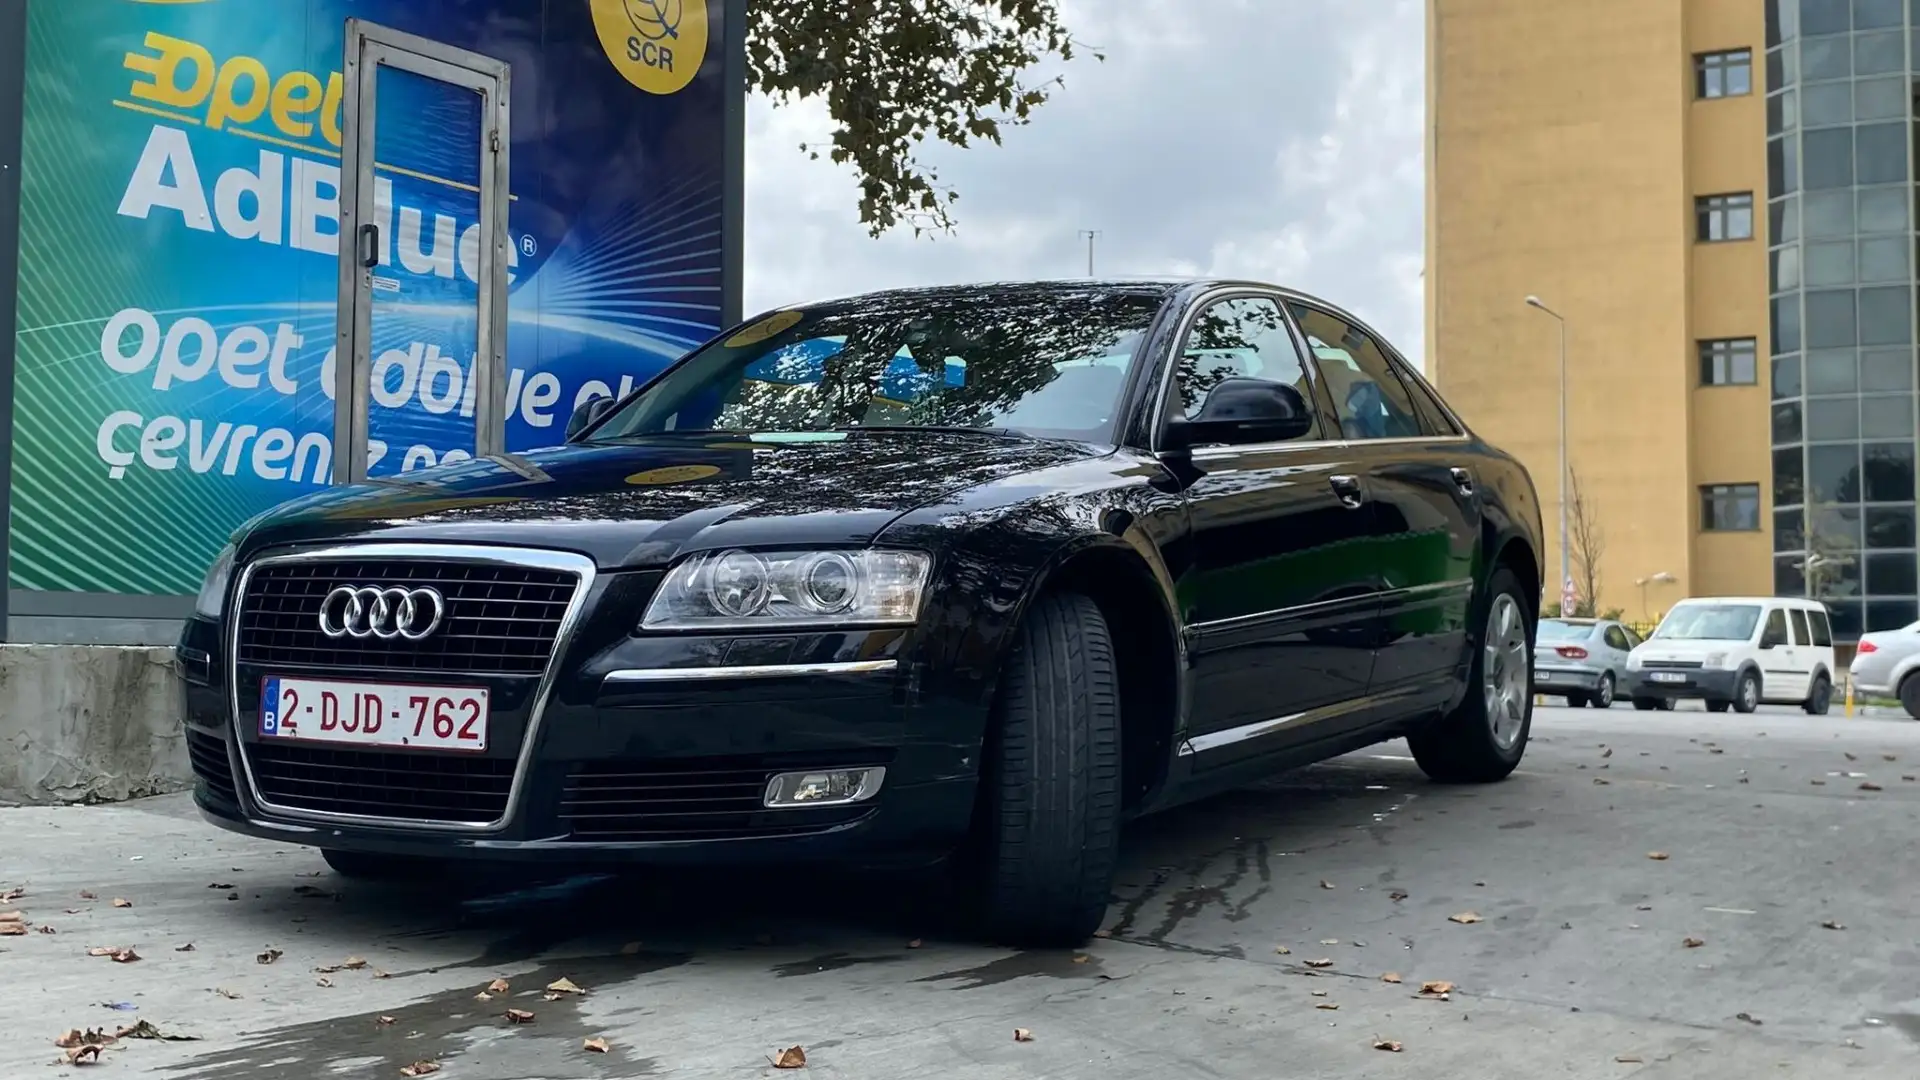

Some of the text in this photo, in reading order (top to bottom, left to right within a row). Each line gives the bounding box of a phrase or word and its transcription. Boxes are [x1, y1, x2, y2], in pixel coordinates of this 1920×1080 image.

[627, 35, 673, 73] SCR
[101, 308, 304, 395] opet
[97, 410, 388, 486] çevrenz
[264, 688, 481, 740] B 2-DJD-762
